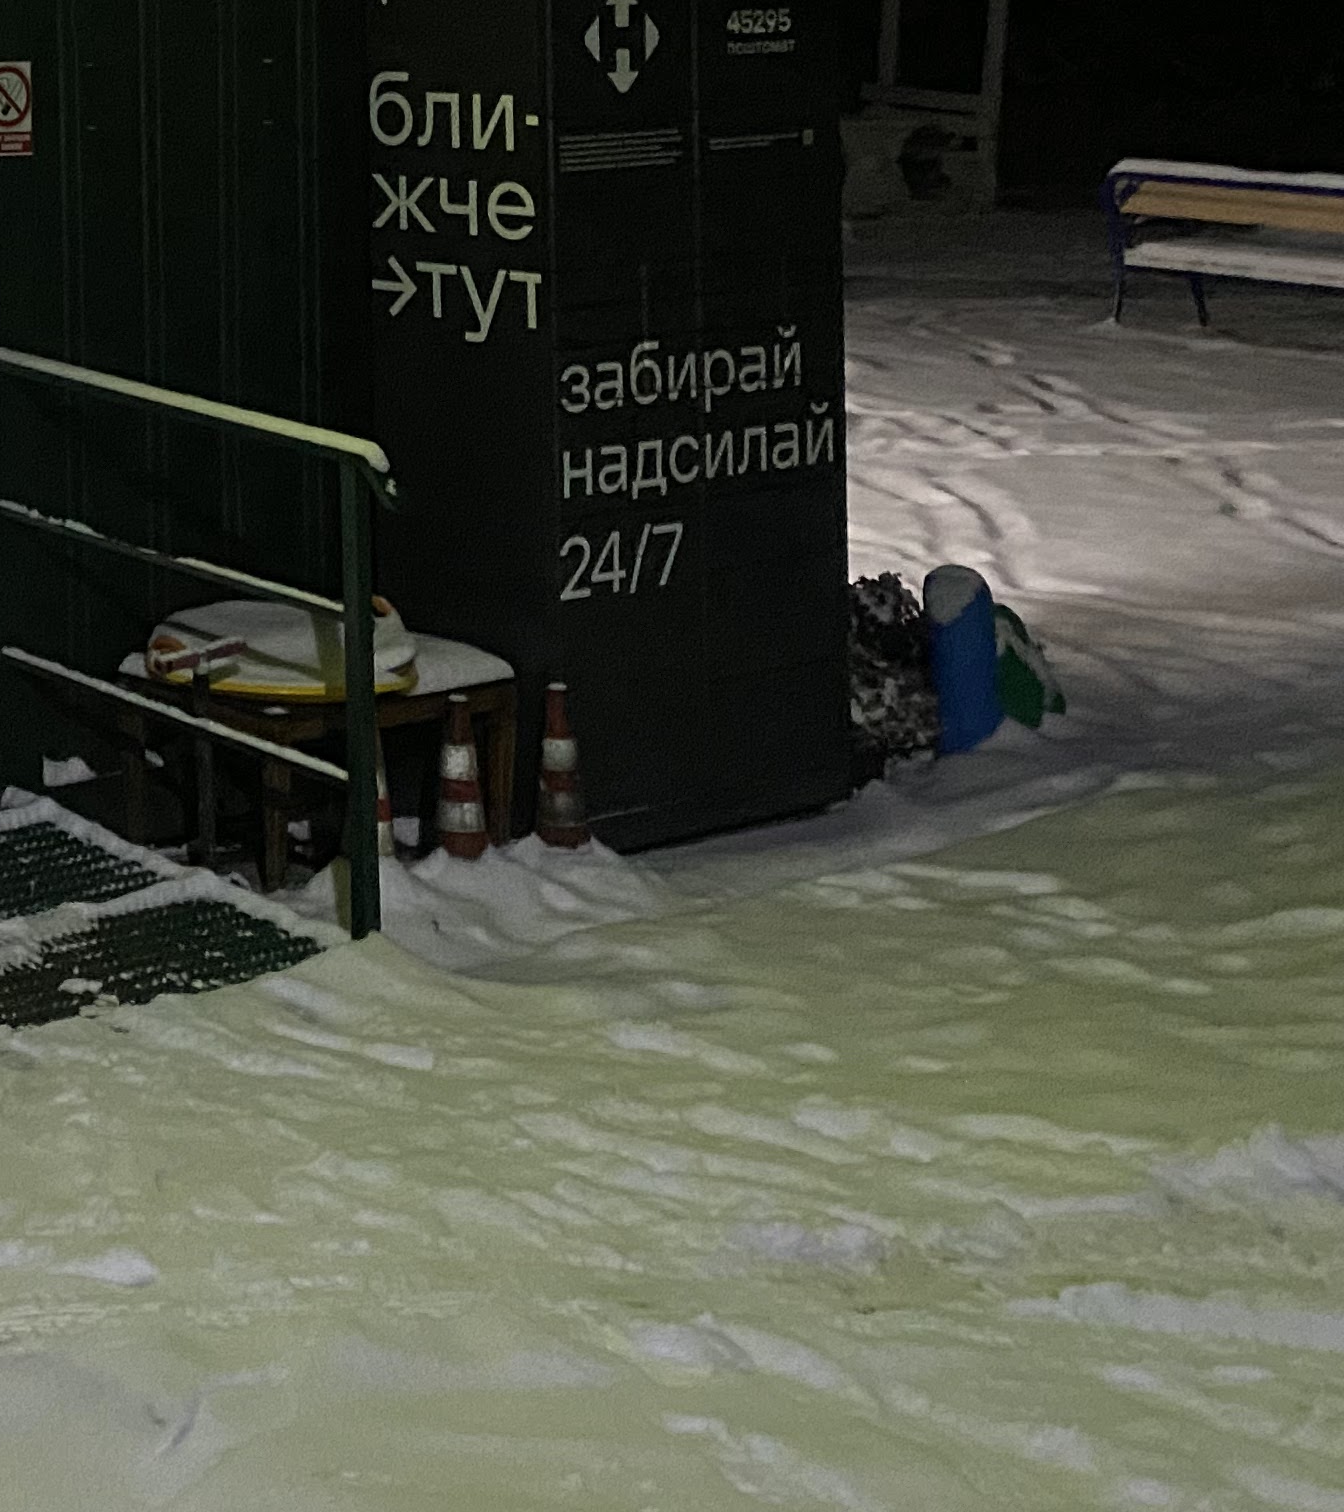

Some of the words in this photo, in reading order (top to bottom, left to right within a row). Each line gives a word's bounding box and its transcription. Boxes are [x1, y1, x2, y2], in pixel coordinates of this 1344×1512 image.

[726, 8, 792, 34] 45295
[369, 71, 539, 152] бли-
[371, 173, 536, 241] жче
[415, 261, 542, 343] тут
[560, 325, 802, 413] забирай
[561, 401, 835, 501] надсилай
[559, 522, 684, 602] 24/7
